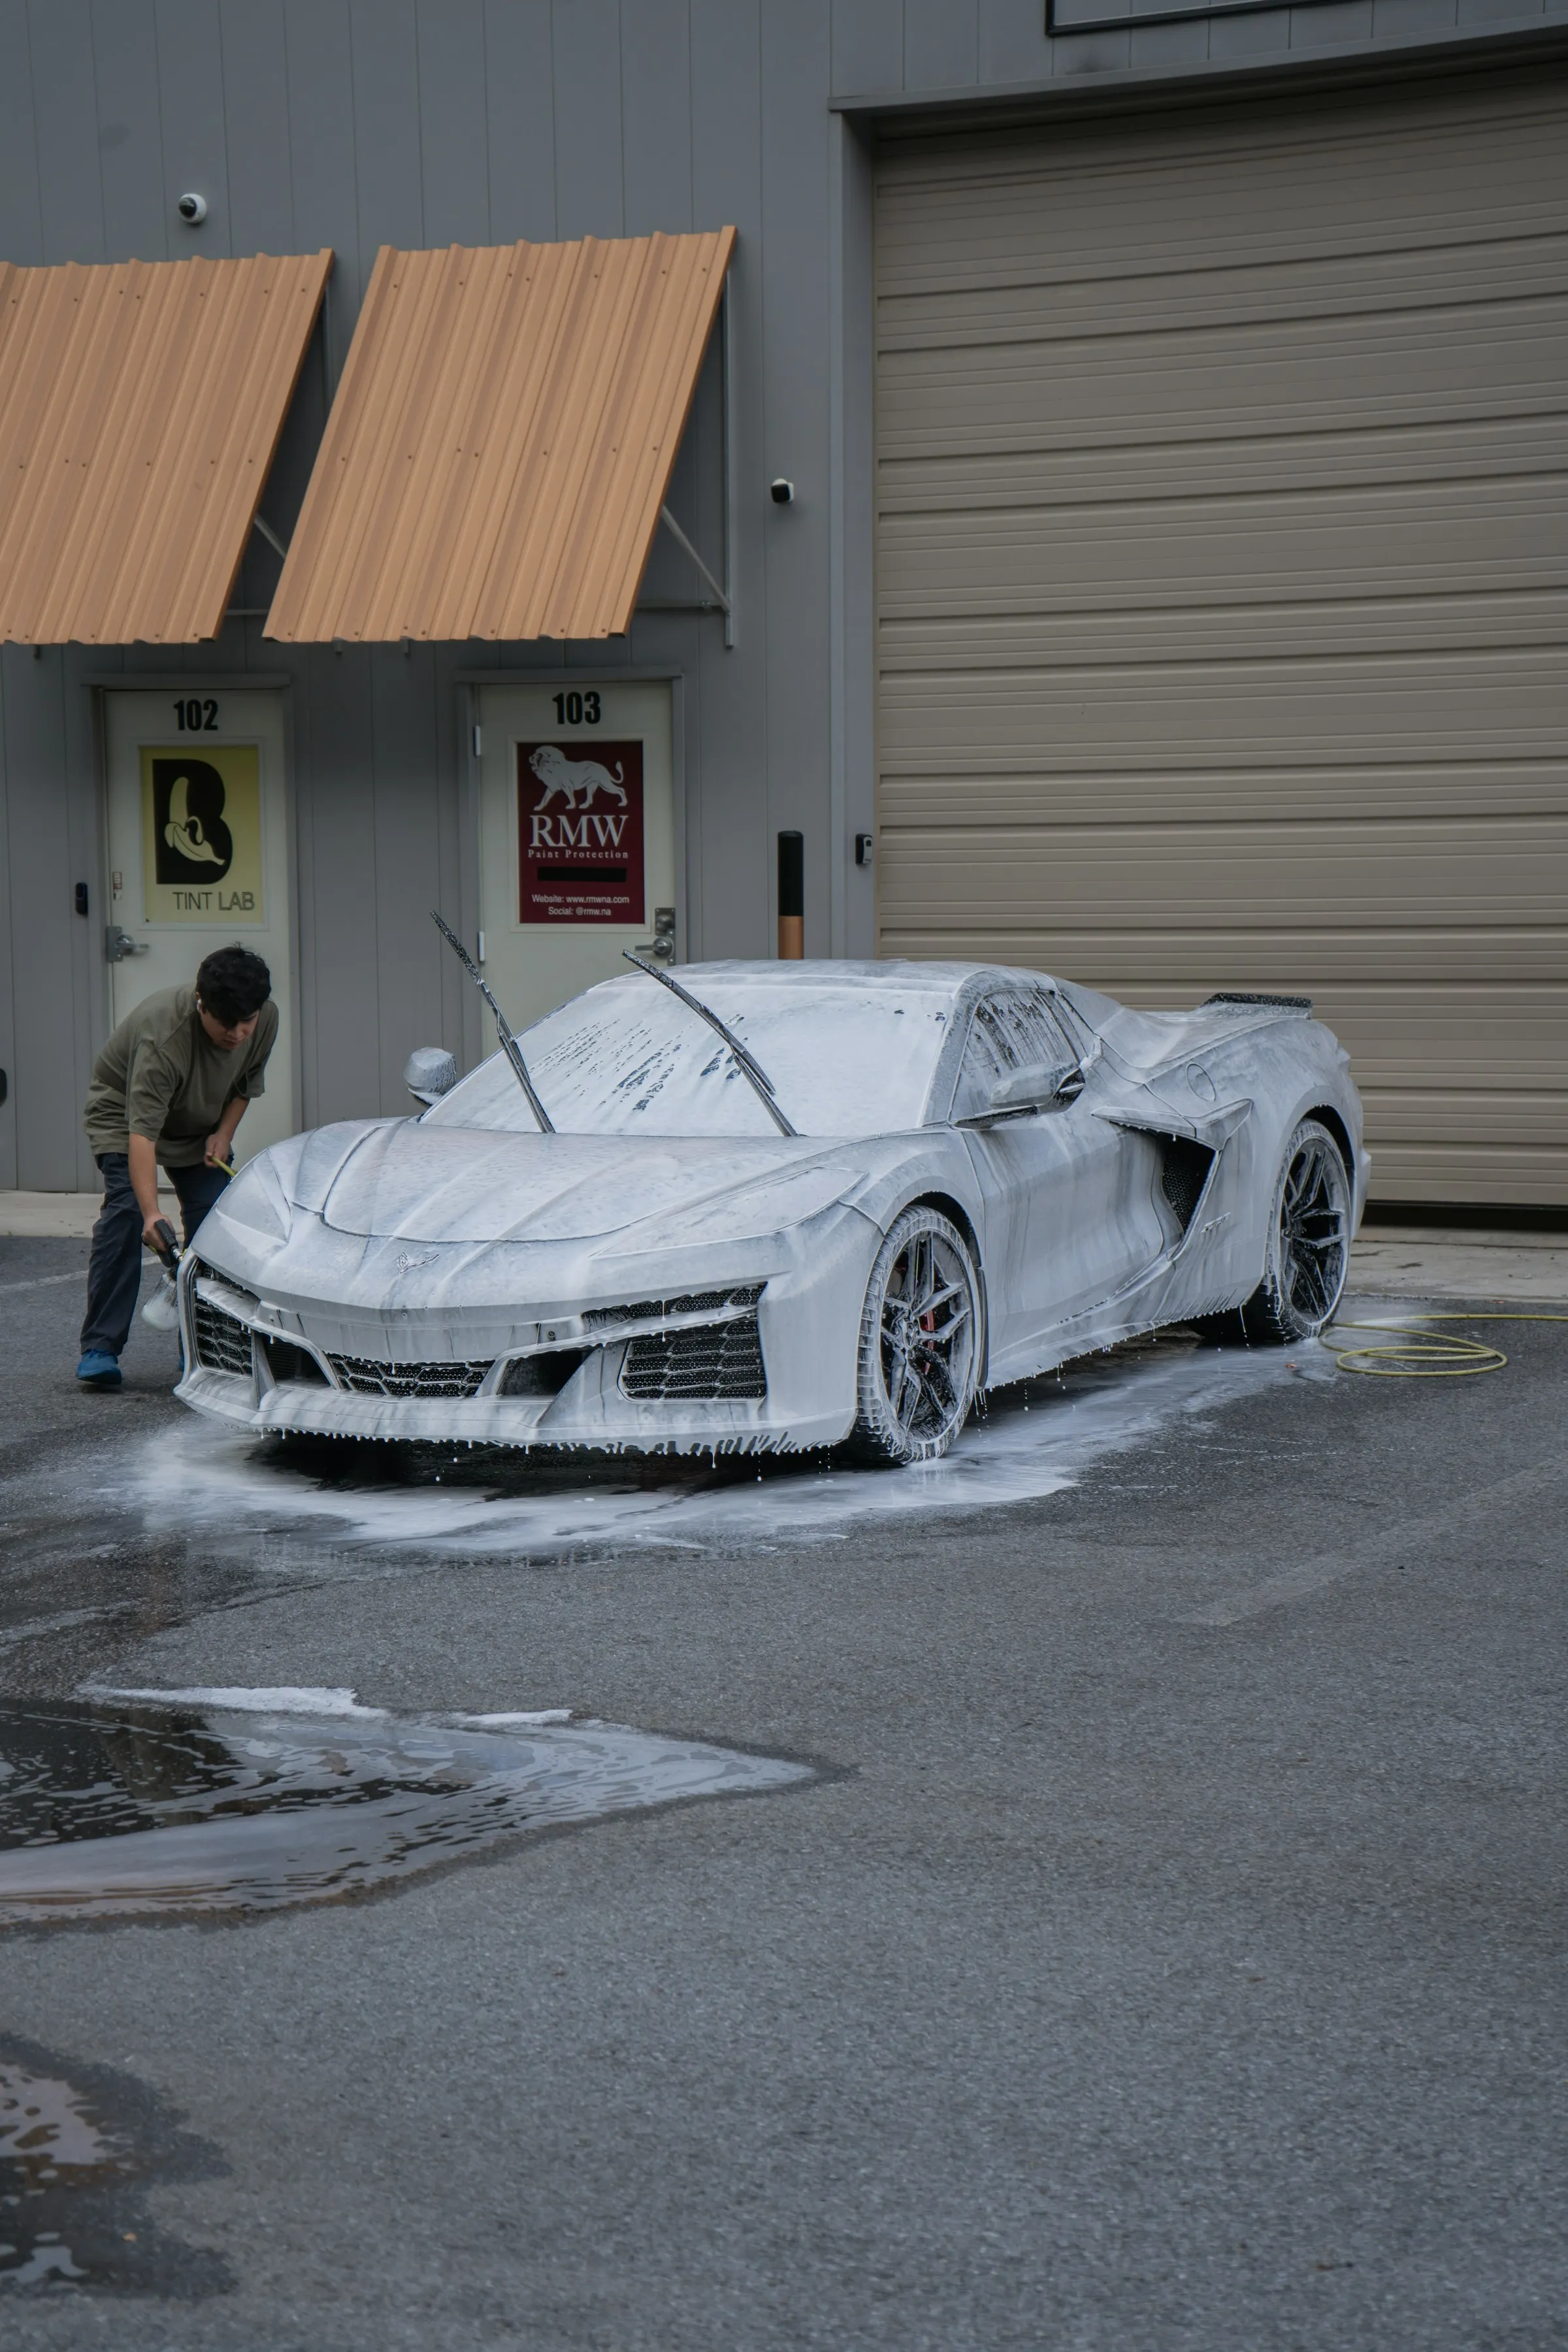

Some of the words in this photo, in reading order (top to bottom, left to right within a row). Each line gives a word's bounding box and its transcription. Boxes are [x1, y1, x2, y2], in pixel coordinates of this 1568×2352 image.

[173, 699, 218, 731] 102
[552, 691, 601, 725] 103
[152, 759, 233, 885] B
[529, 815, 629, 847] RMW
[528, 849, 559, 858] Paint
[565, 849, 628, 858] Protection
[172, 891, 213, 910] TINT
[218, 891, 255, 911] LAB
[531, 894, 564, 903] Website:
[566, 895, 630, 904] www.rmwna.com
[548, 906, 573, 915] Social:
[576, 907, 611, 916] @rmw.na
